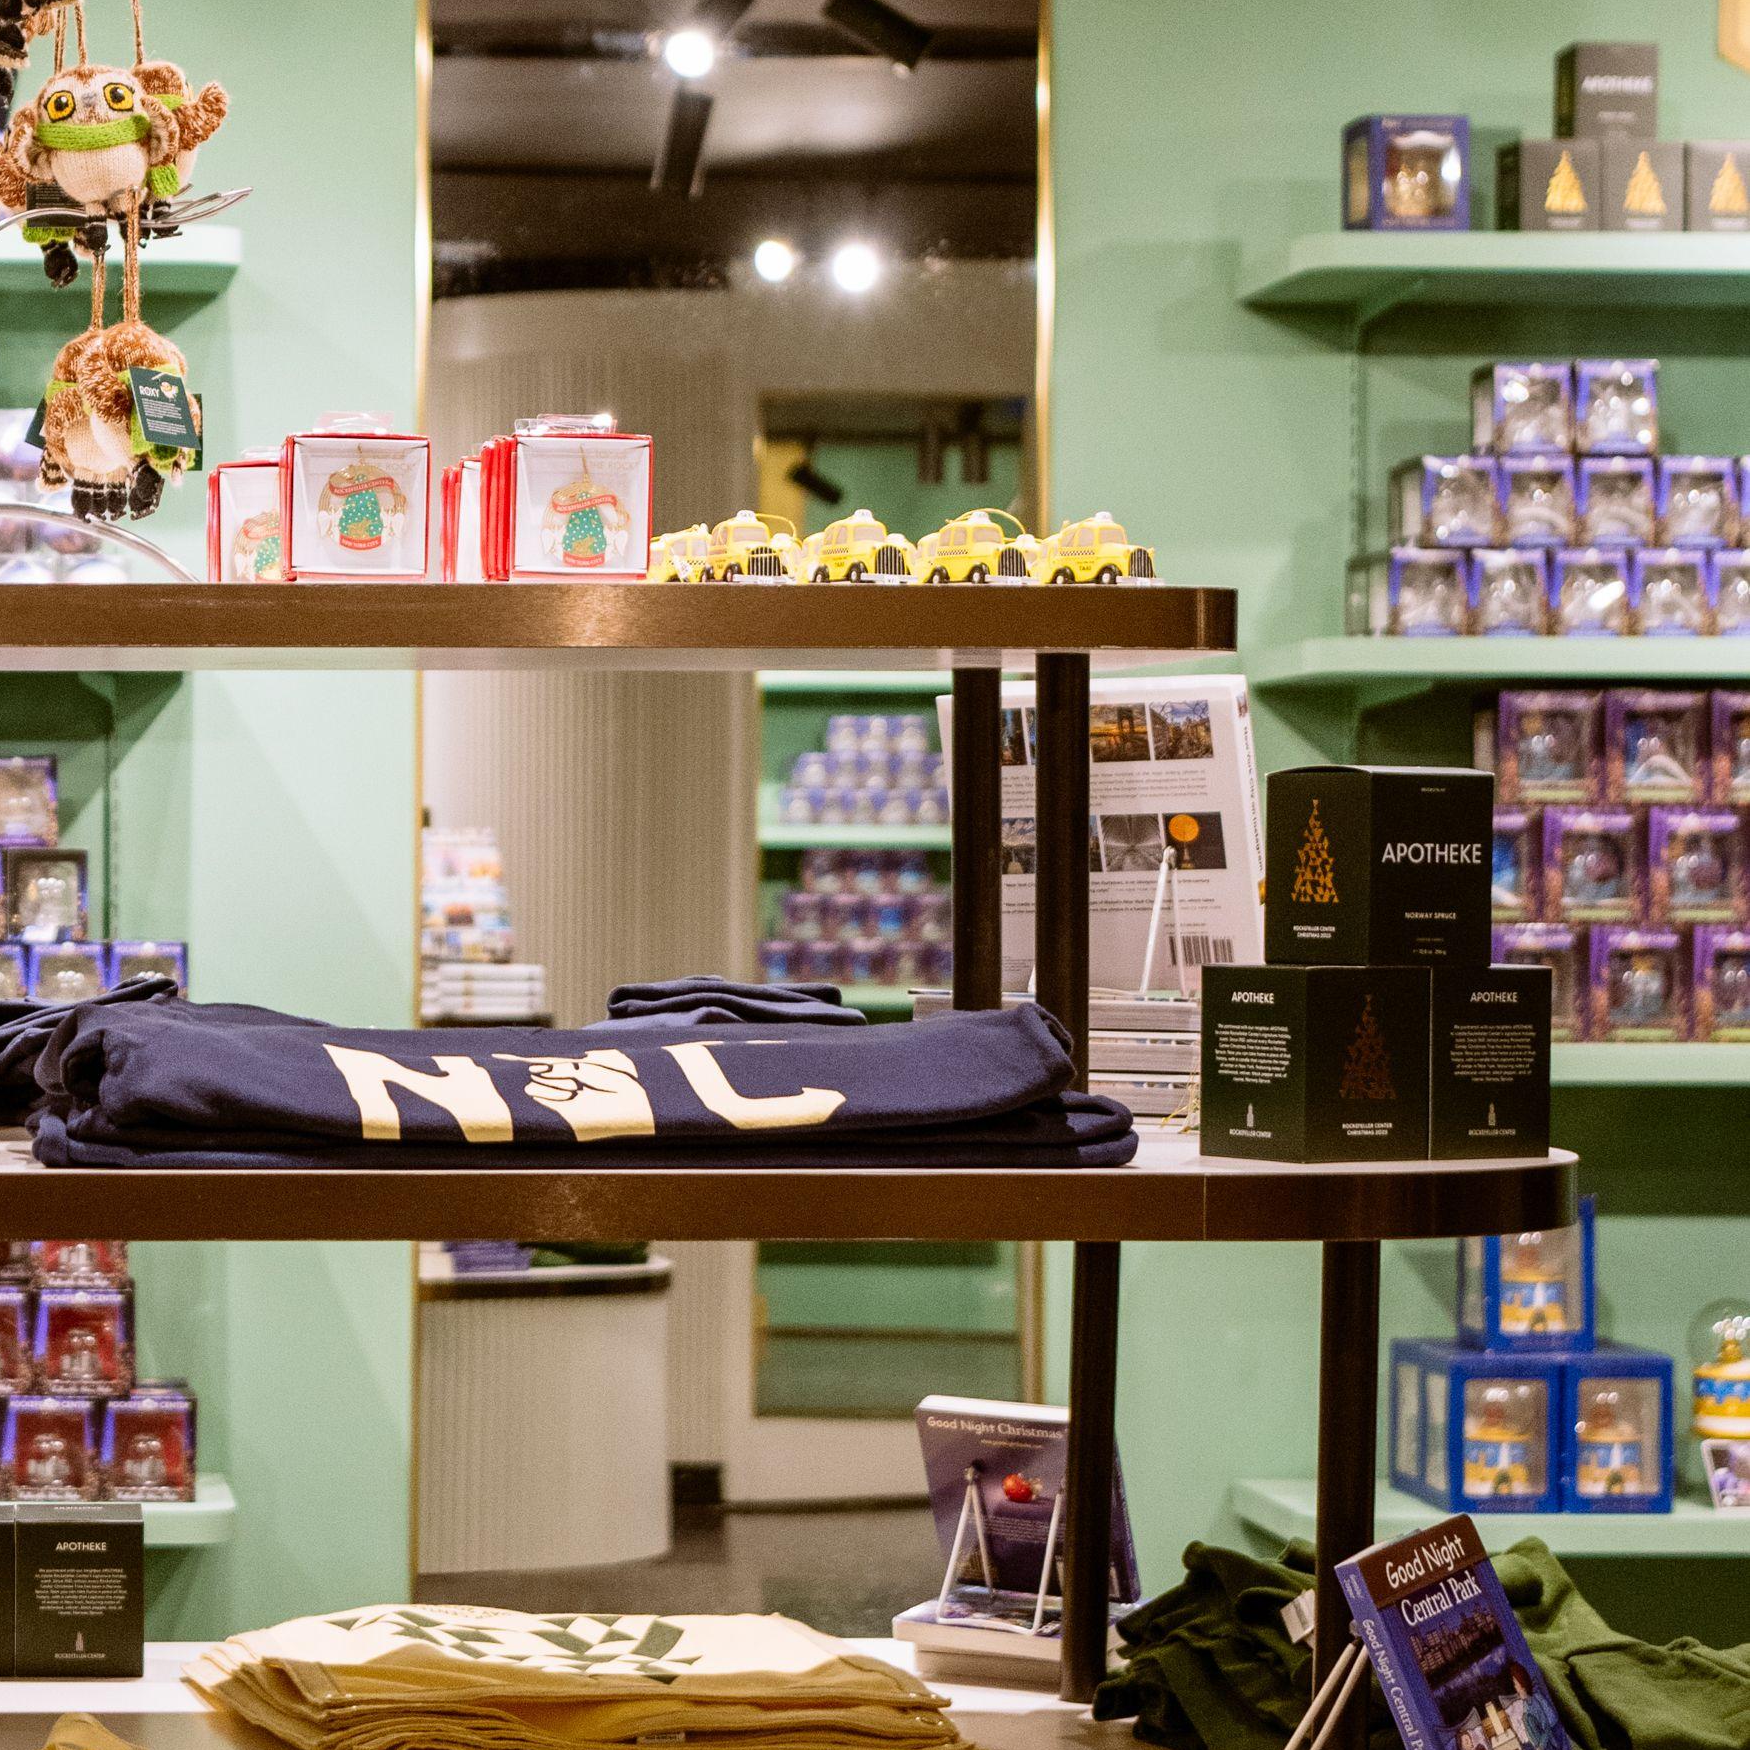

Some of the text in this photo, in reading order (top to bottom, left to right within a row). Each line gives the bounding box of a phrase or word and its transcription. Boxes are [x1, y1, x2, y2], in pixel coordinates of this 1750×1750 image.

[139, 385, 159, 397] ROXY
[1381, 842, 1482, 864] APOTHEKE
[1404, 912, 1456, 920] NORWAY SPRUCE
[1231, 991, 1275, 1004] APOTHEKE
[1470, 991, 1518, 1003] APOTHEKE
[927, 1416, 1063, 1439] Good Night Christmas
[55, 1542, 107, 1551] APOTHEKE
[1385, 1534, 1467, 1589] Good Night
[1401, 1569, 1482, 1627] Central Park
[1361, 1617, 1380, 1649] Good
[1375, 1649, 1396, 1687] Night
[1390, 1686, 1418, 1739] Central
